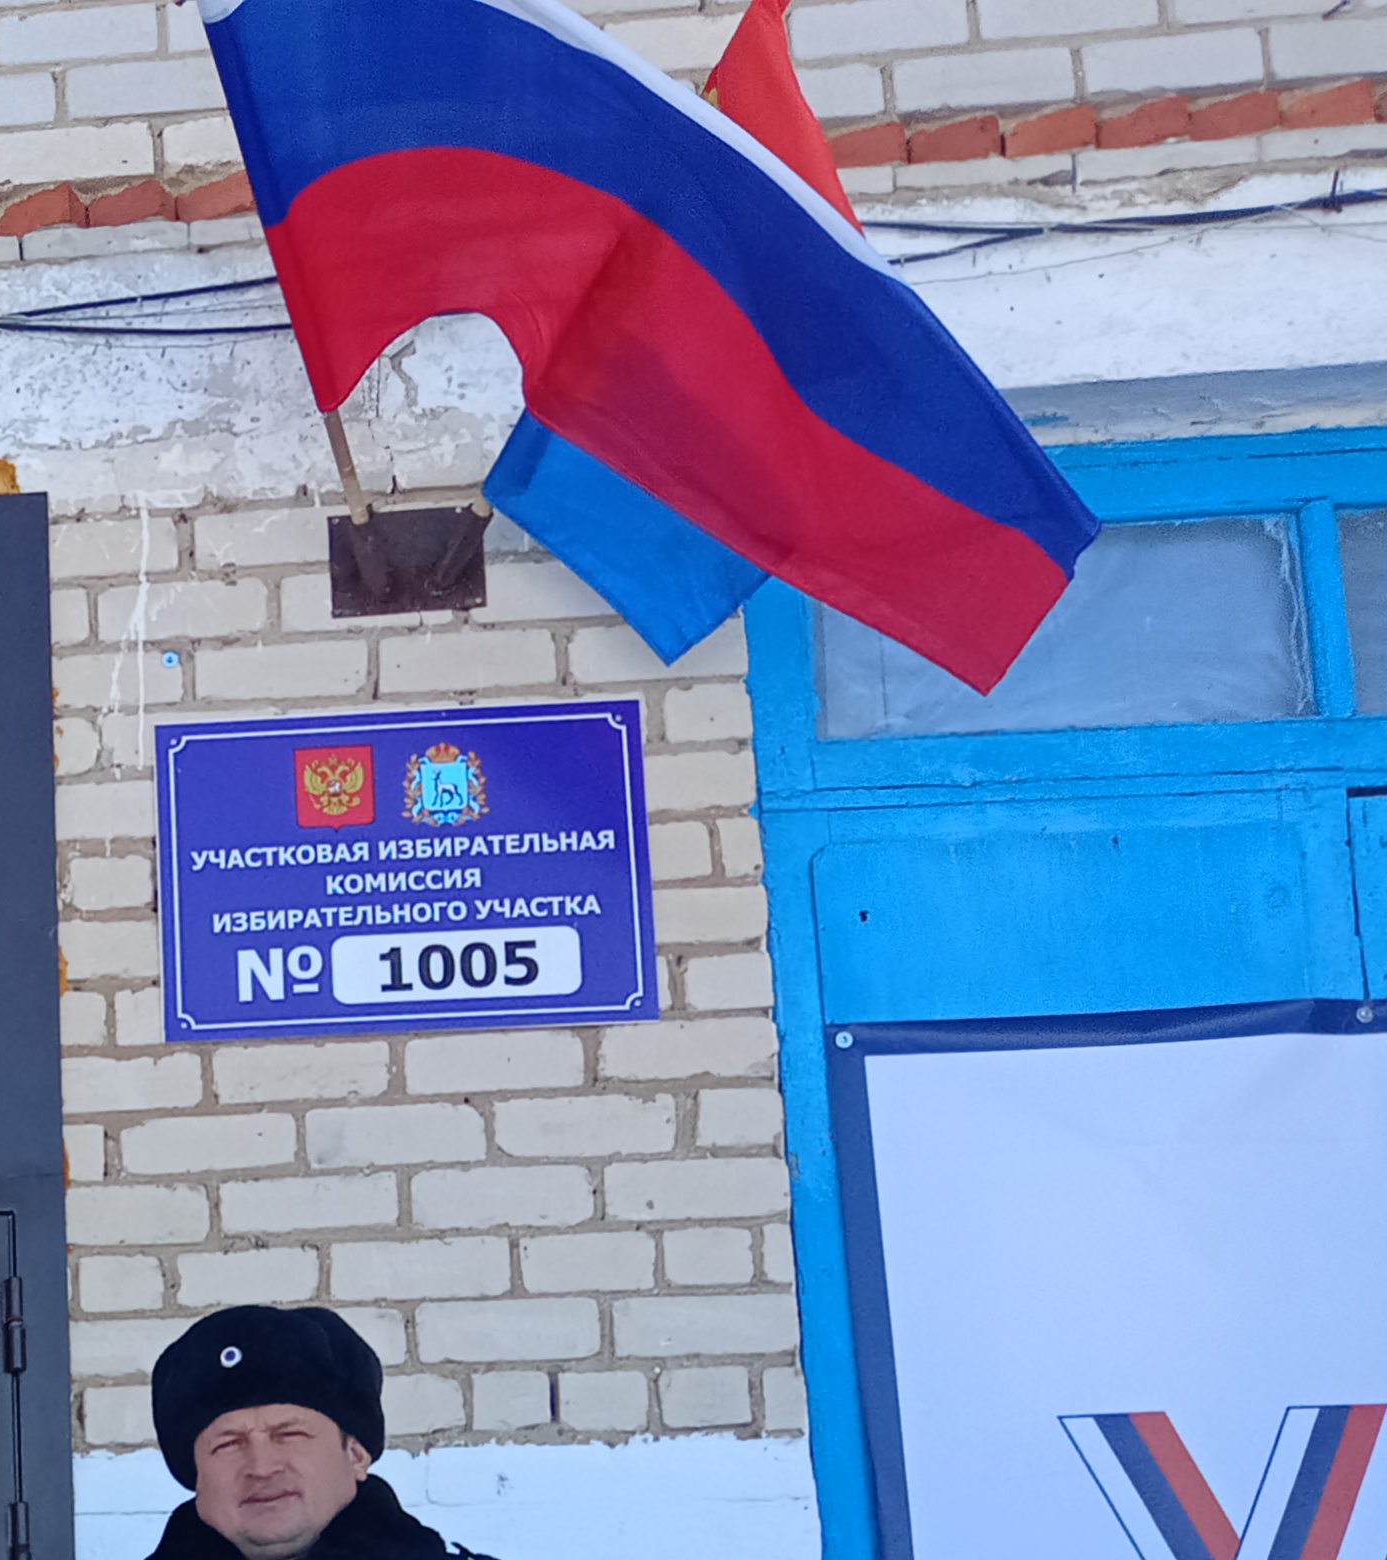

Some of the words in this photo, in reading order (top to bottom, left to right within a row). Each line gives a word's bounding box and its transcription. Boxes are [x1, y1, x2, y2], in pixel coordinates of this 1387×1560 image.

[190, 841, 370, 871] УЧАСТКОВАЯ
[377, 829, 616, 861] ИЗБИРАТЕЛЬНАЯ
[325, 867, 482, 896] КОМИССИЯ
[211, 901, 468, 934] ИЗБИРАТЕЛЬНОГО
[474, 894, 602, 922] УЧАСТКА
[378, 939, 541, 993] 1005
